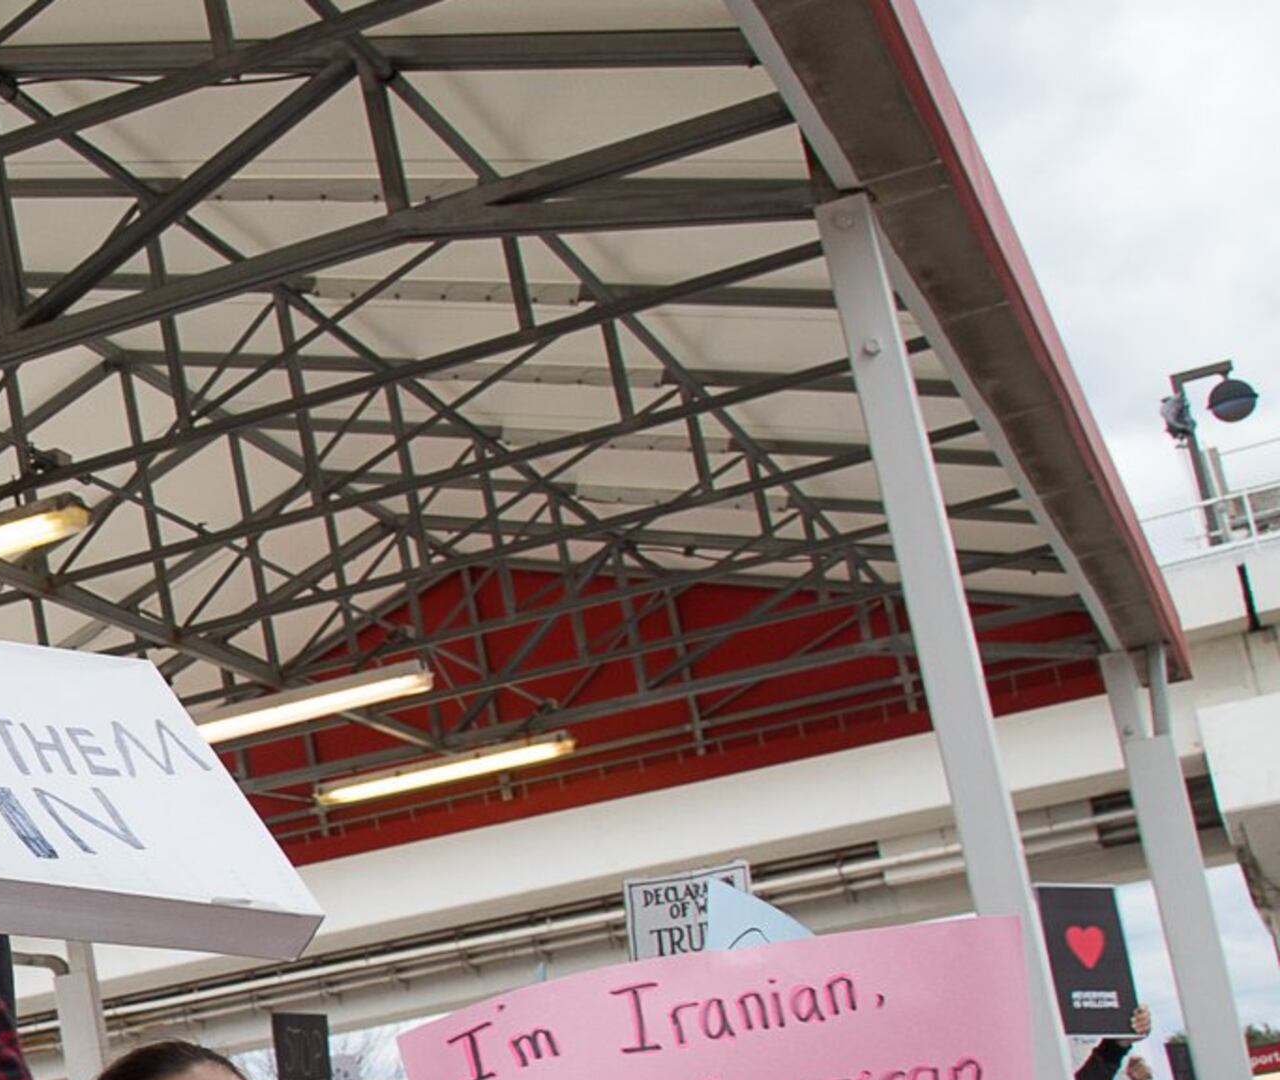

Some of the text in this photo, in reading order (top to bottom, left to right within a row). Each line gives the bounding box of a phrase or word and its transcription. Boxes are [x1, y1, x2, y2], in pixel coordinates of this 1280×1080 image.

[669, 901, 690, 919] OF
[649, 922, 708, 957] TRU
[610, 972, 887, 1055] Iranian,
